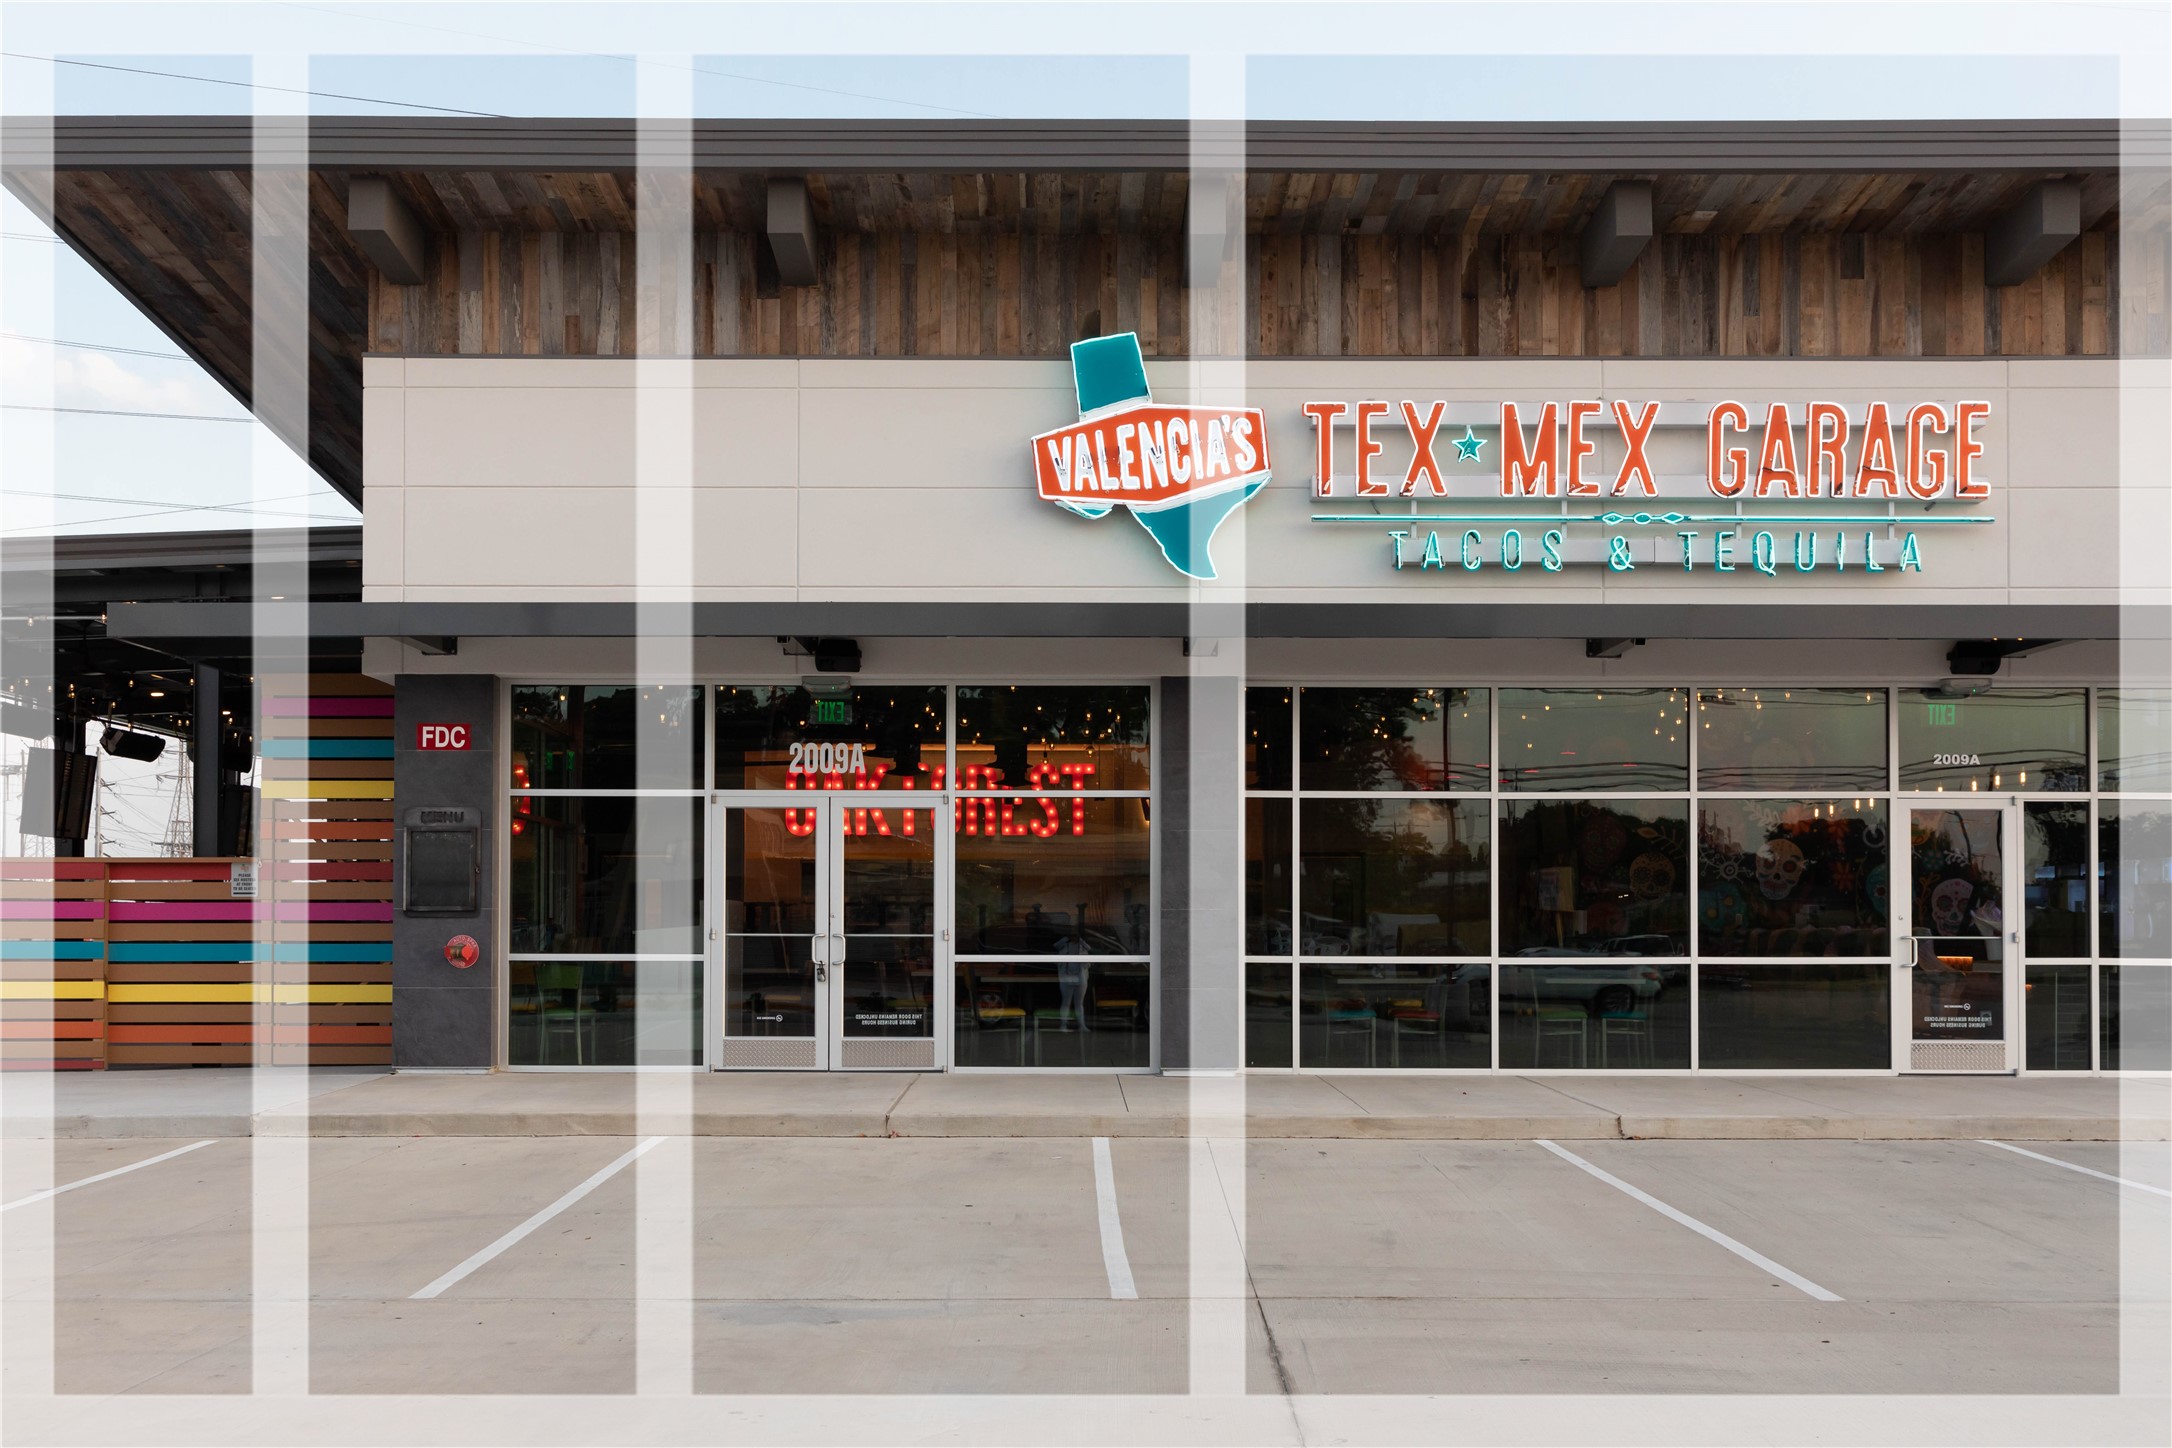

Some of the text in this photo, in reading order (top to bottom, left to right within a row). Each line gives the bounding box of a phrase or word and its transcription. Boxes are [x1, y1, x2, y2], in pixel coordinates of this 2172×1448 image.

[1046, 414, 1258, 492] VALENCIA'S
[1302, 399, 1992, 501] TEX MEX GARAGE
[1388, 530, 1924, 578] TACOS & TEQUILA
[422, 726, 466, 748] FDC
[789, 742, 866, 774] 2009A
[1933, 753, 1981, 765] 2009A
[420, 811, 465, 824] MENU
